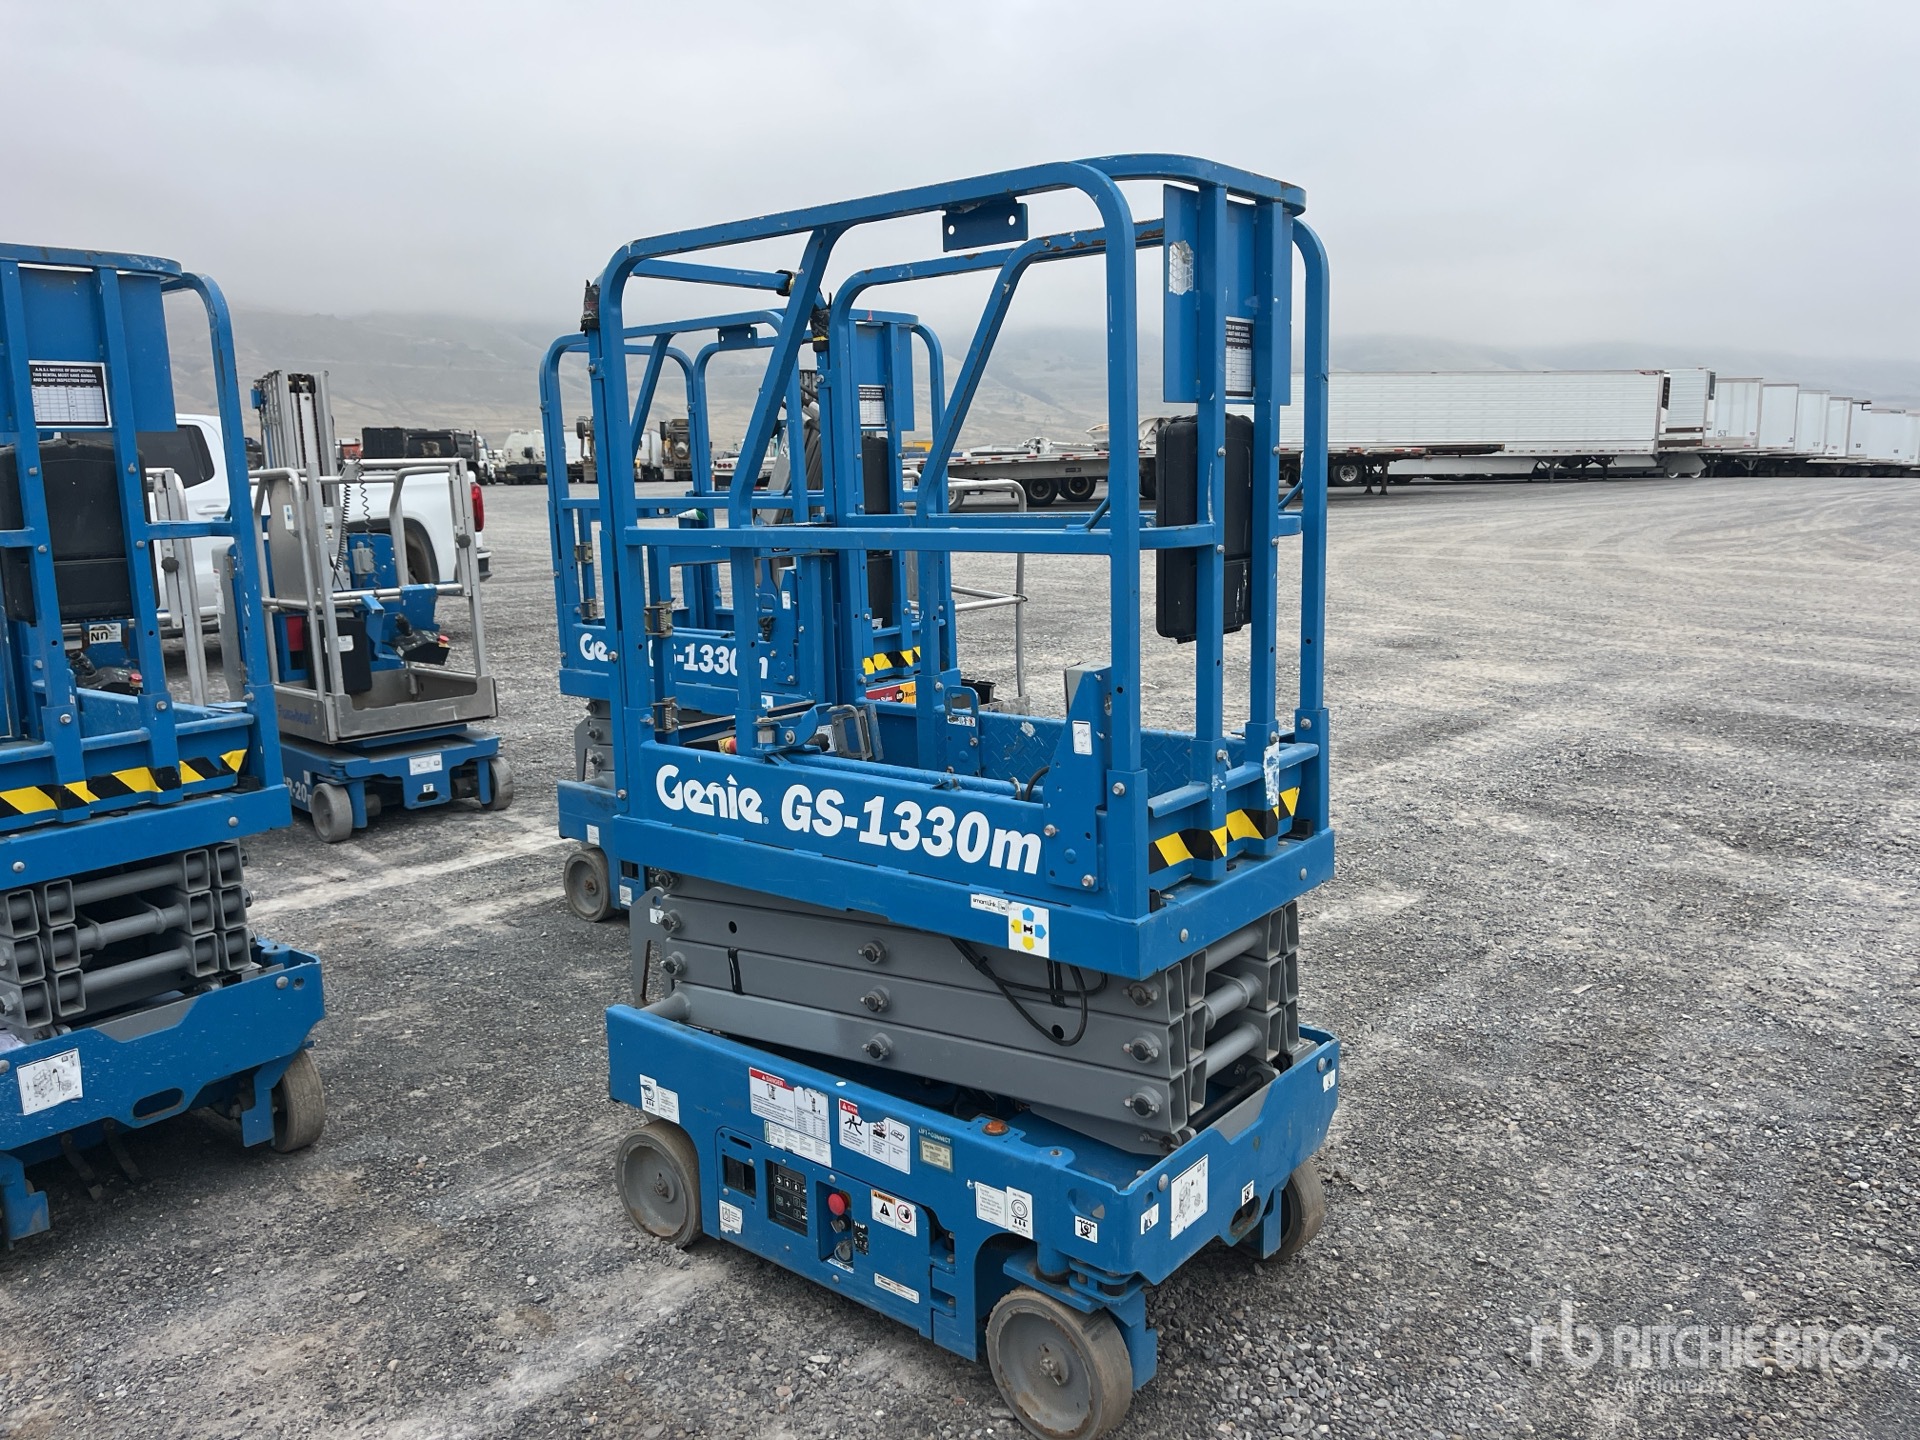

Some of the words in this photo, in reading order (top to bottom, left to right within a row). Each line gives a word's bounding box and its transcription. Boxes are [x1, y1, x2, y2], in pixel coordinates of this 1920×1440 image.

[283, 776, 308, 803] R-20
[656, 764, 763, 824] Genie
[781, 784, 1042, 875] GS-1330m
